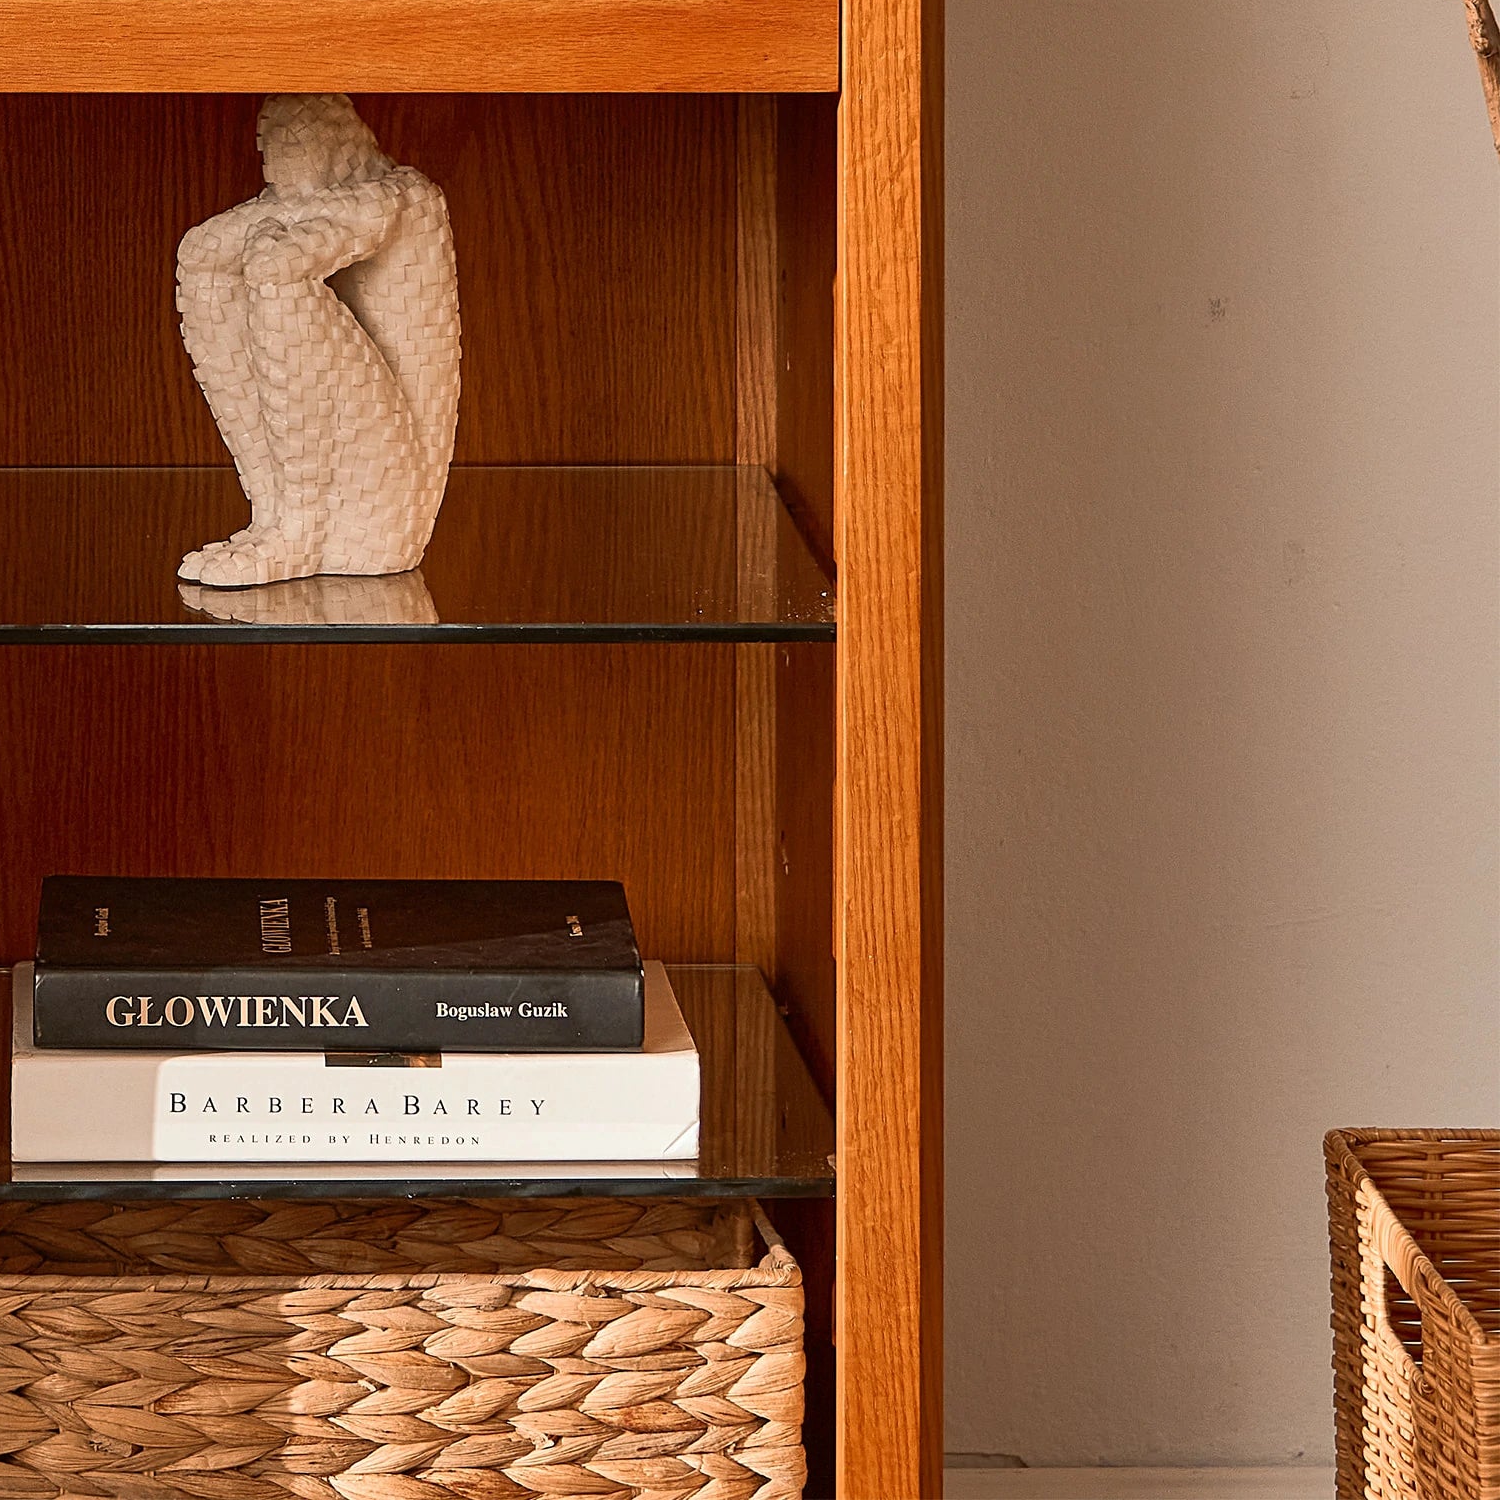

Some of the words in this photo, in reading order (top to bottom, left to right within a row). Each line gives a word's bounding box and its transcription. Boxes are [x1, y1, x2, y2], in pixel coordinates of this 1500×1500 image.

[105, 995, 369, 1028] GŁOWIENKA
[435, 1002, 513, 1021] Boguslaw
[518, 1002, 568, 1018] Guzik
[169, 1092, 380, 1115] BARBERA
[403, 1095, 546, 1116] BAREY
[209, 1134, 311, 1145] REALIZED
[328, 1135, 351, 1145] BY
[369, 1133, 481, 1146] HENREDON
